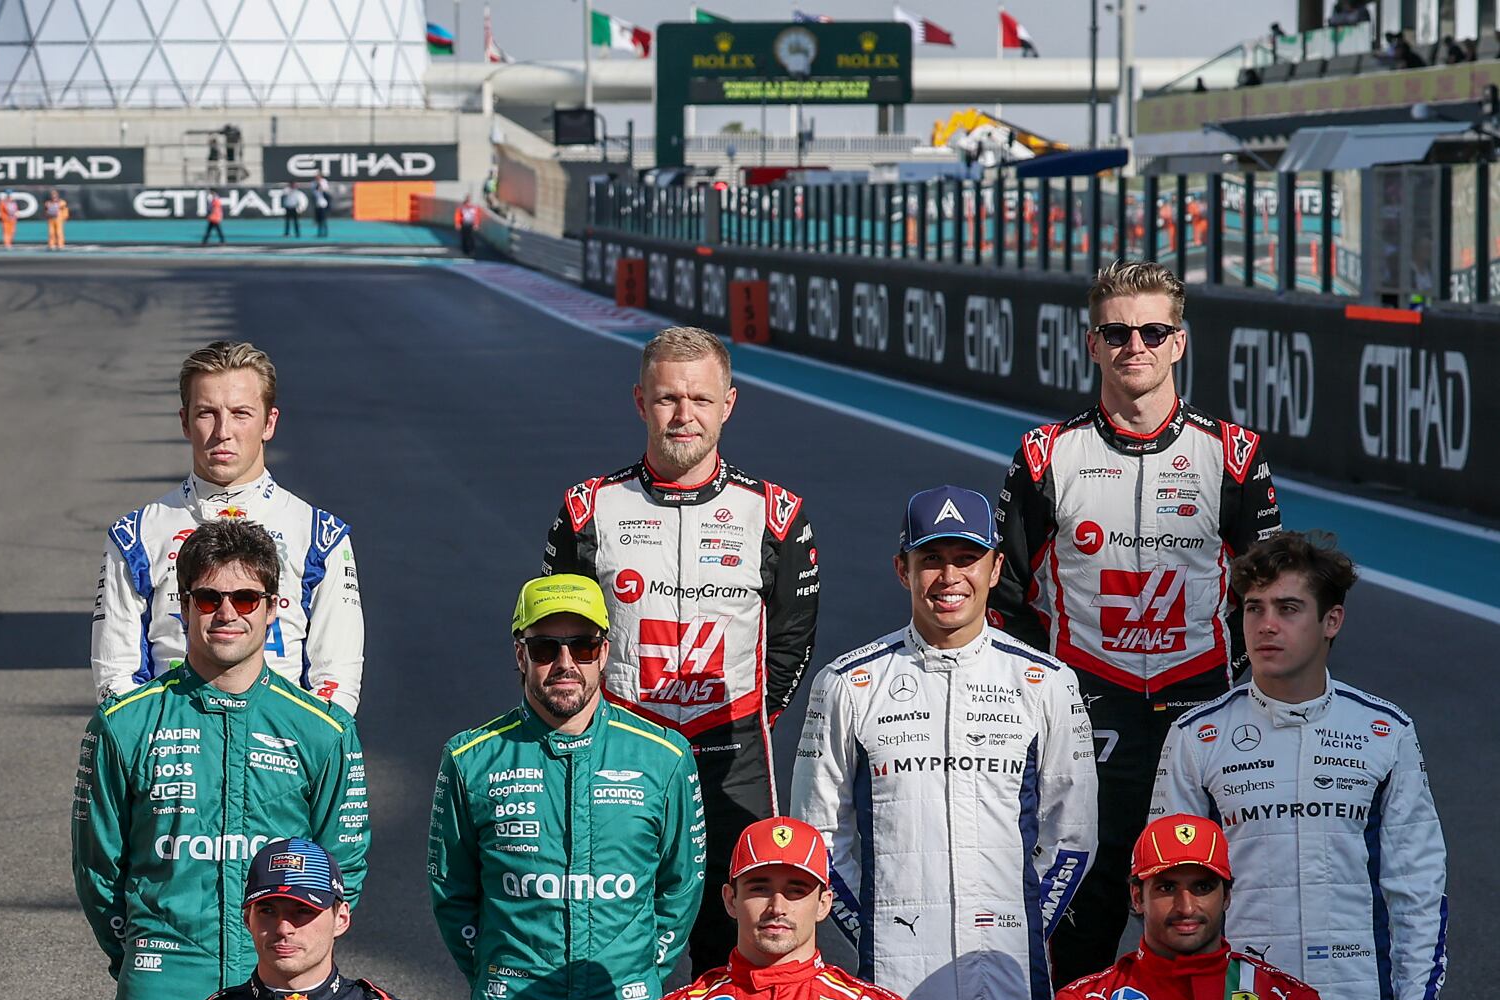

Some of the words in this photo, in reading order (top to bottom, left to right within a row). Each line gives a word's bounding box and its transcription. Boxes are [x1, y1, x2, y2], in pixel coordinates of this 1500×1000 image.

[692, 55, 755, 68] ROLEX
[837, 55, 899, 68] ROLEX
[287, 153, 435, 177] ETIHAD
[744, 287, 756, 340] 150
[964, 295, 1013, 376] ETIHAD
[1229, 327, 1314, 438] ETIHAD
[1359, 345, 1470, 471] ETIHAD
[1159, 471, 1200, 479] MoneyGram
[701, 523, 743, 531] MoneyGram
[1109, 531, 1204, 551] MoneyGram
[650, 581, 748, 601] MoneyGram
[1102, 627, 1185, 649] HAAS
[850, 673, 872, 683] Gulf
[1024, 671, 1045, 681] Gulf
[642, 677, 726, 702] HAAS
[966, 683, 1022, 698] WILLIAMS
[209, 697, 247, 708] aramco
[972, 693, 1015, 704] RACING
[877, 711, 931, 725] KOMATSU
[966, 712, 1022, 724] DURACELL
[1197, 727, 1219, 739] Gulf
[1371, 723, 1391, 733] Gulf
[877, 731, 931, 746] Stephens
[989, 732, 1022, 741] mercado
[989, 738, 1006, 746] libre
[1314, 728, 1369, 743] WILLIAMS
[148, 742, 201, 758] cognizant
[557, 737, 592, 749] aramco
[250, 752, 298, 769] aramco
[893, 756, 1023, 775] MYPROTEIN
[1222, 758, 1275, 775] KOMATSU
[1314, 755, 1367, 770] DURACELL
[154, 763, 193, 777] BOSS
[1223, 779, 1275, 796] Stephens
[1336, 777, 1368, 786] mercado
[1336, 782, 1353, 791] libre
[152, 784, 193, 798] JCB
[488, 784, 544, 798] cognizant
[594, 788, 644, 800] aramco
[152, 806, 195, 815] SentinelOne
[496, 802, 536, 816] BOSS
[1241, 802, 1366, 822] MYPROTEIN
[497, 822, 539, 836] JCB
[496, 844, 539, 853] SentinelOne
[502, 873, 636, 899] aramco
[150, 939, 180, 950] STROLL
[134, 954, 162, 968] OMP
[1332, 951, 1370, 959] COLAPINTO
[497, 968, 529, 977] ALONSO
[487, 982, 507, 996] OMP
[623, 984, 647, 998] OMP
